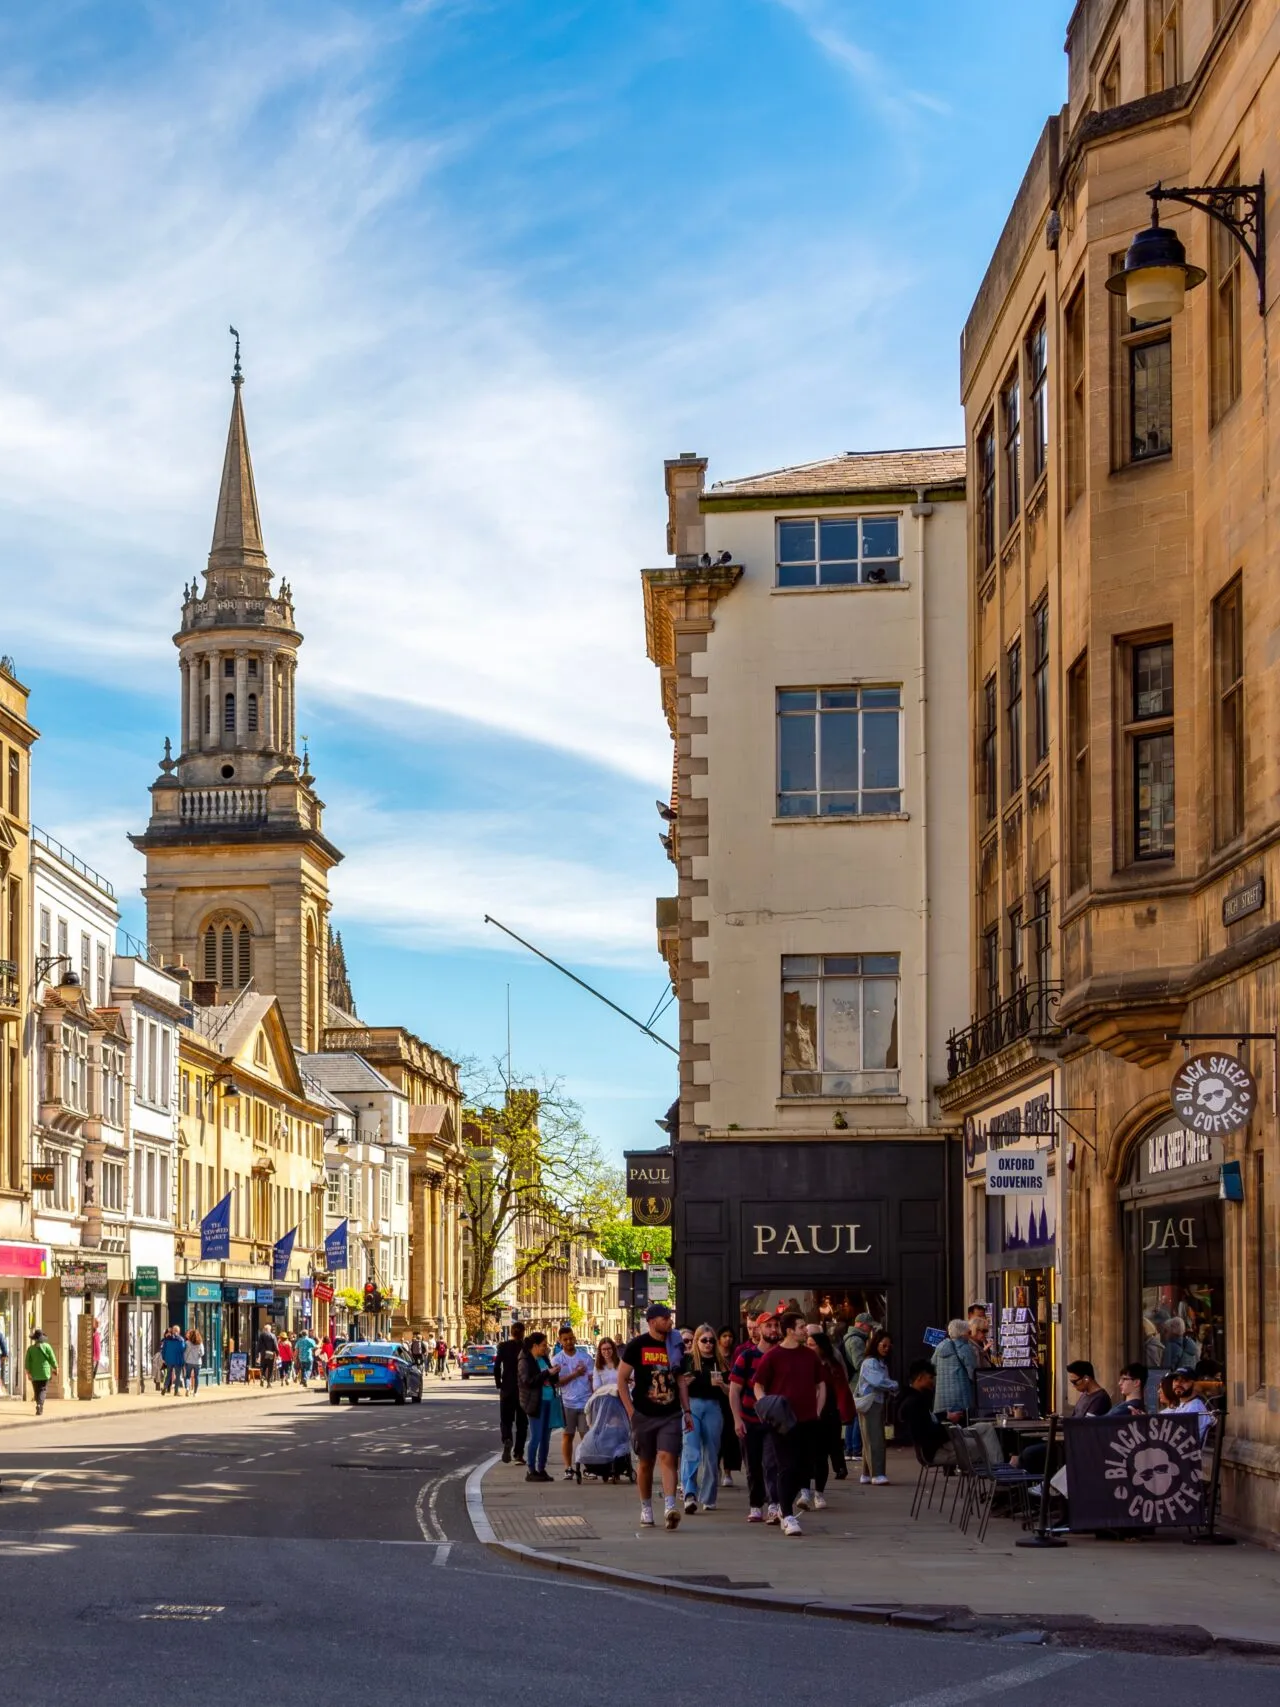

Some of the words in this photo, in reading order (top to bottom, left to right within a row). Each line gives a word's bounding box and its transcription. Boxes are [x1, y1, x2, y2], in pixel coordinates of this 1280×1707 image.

[1225, 897, 1238, 917] HIGH
[1241, 885, 1259, 909] STREET
[1176, 1059, 1208, 1101] BLACK
[1209, 1056, 1250, 1088] SHEEP
[1193, 1102, 1249, 1132] COFFEE
[998, 1158, 1035, 1171] OXFORD
[1148, 1134, 1167, 1175] BLACK
[1167, 1129, 1185, 1170] SHEEP
[630, 1168, 670, 1180] PAUL
[990, 1175, 1043, 1189] SOUVENIRS
[753, 1224, 872, 1255] PAUL
[644, 1352, 659, 1362] PULP
[1104, 1421, 1147, 1479] BLACK
[1149, 1417, 1202, 1462] SHEEP
[1128, 1482, 1202, 1523] COFFEE
